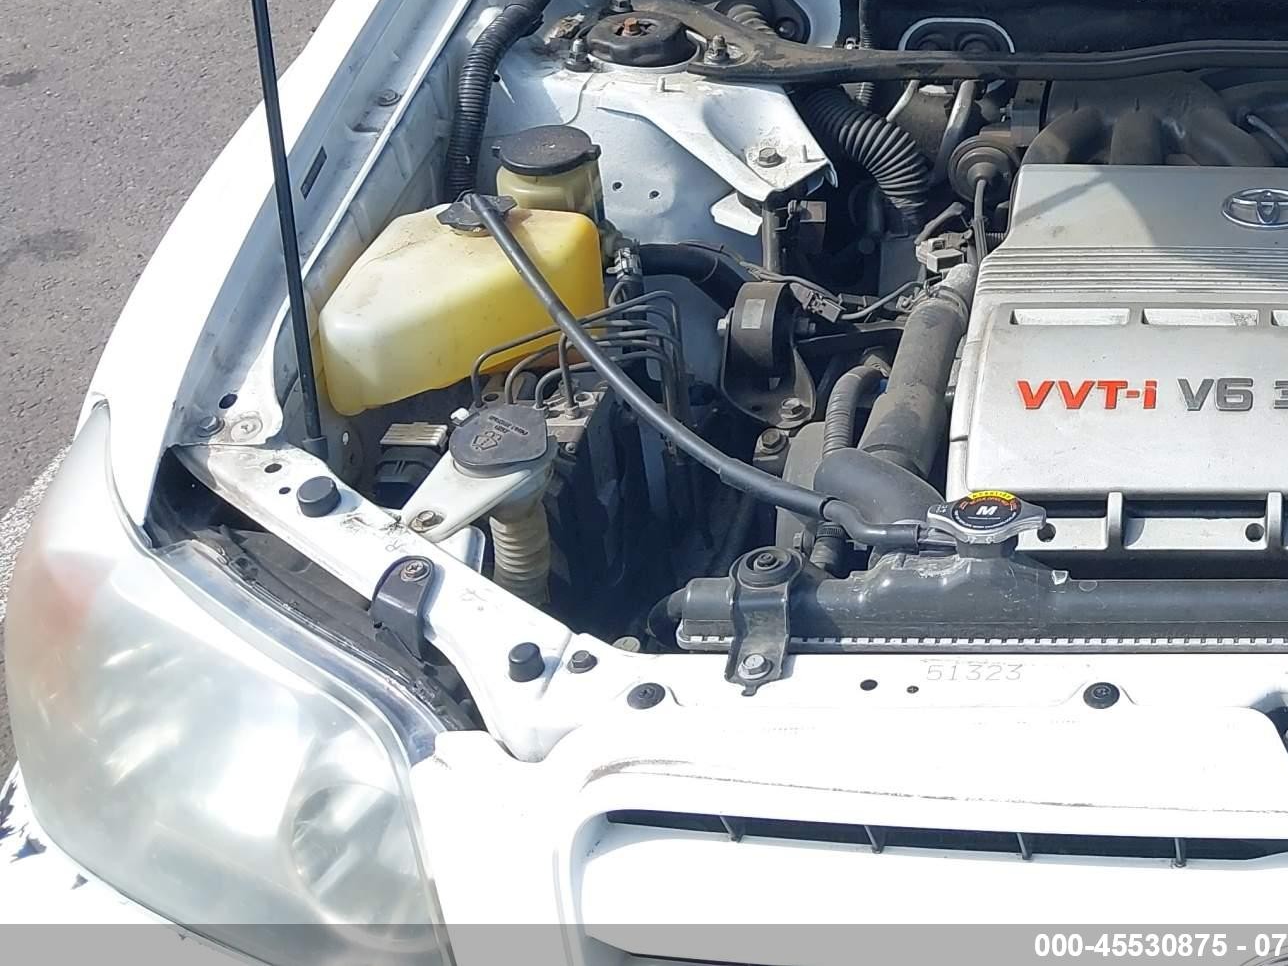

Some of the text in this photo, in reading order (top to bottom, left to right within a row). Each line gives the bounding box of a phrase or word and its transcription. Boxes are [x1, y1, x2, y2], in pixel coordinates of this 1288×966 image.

[1017, 379, 1158, 411] VVT-i
[1177, 377, 1254, 412] V6
[926, 663, 1023, 681] 51323
